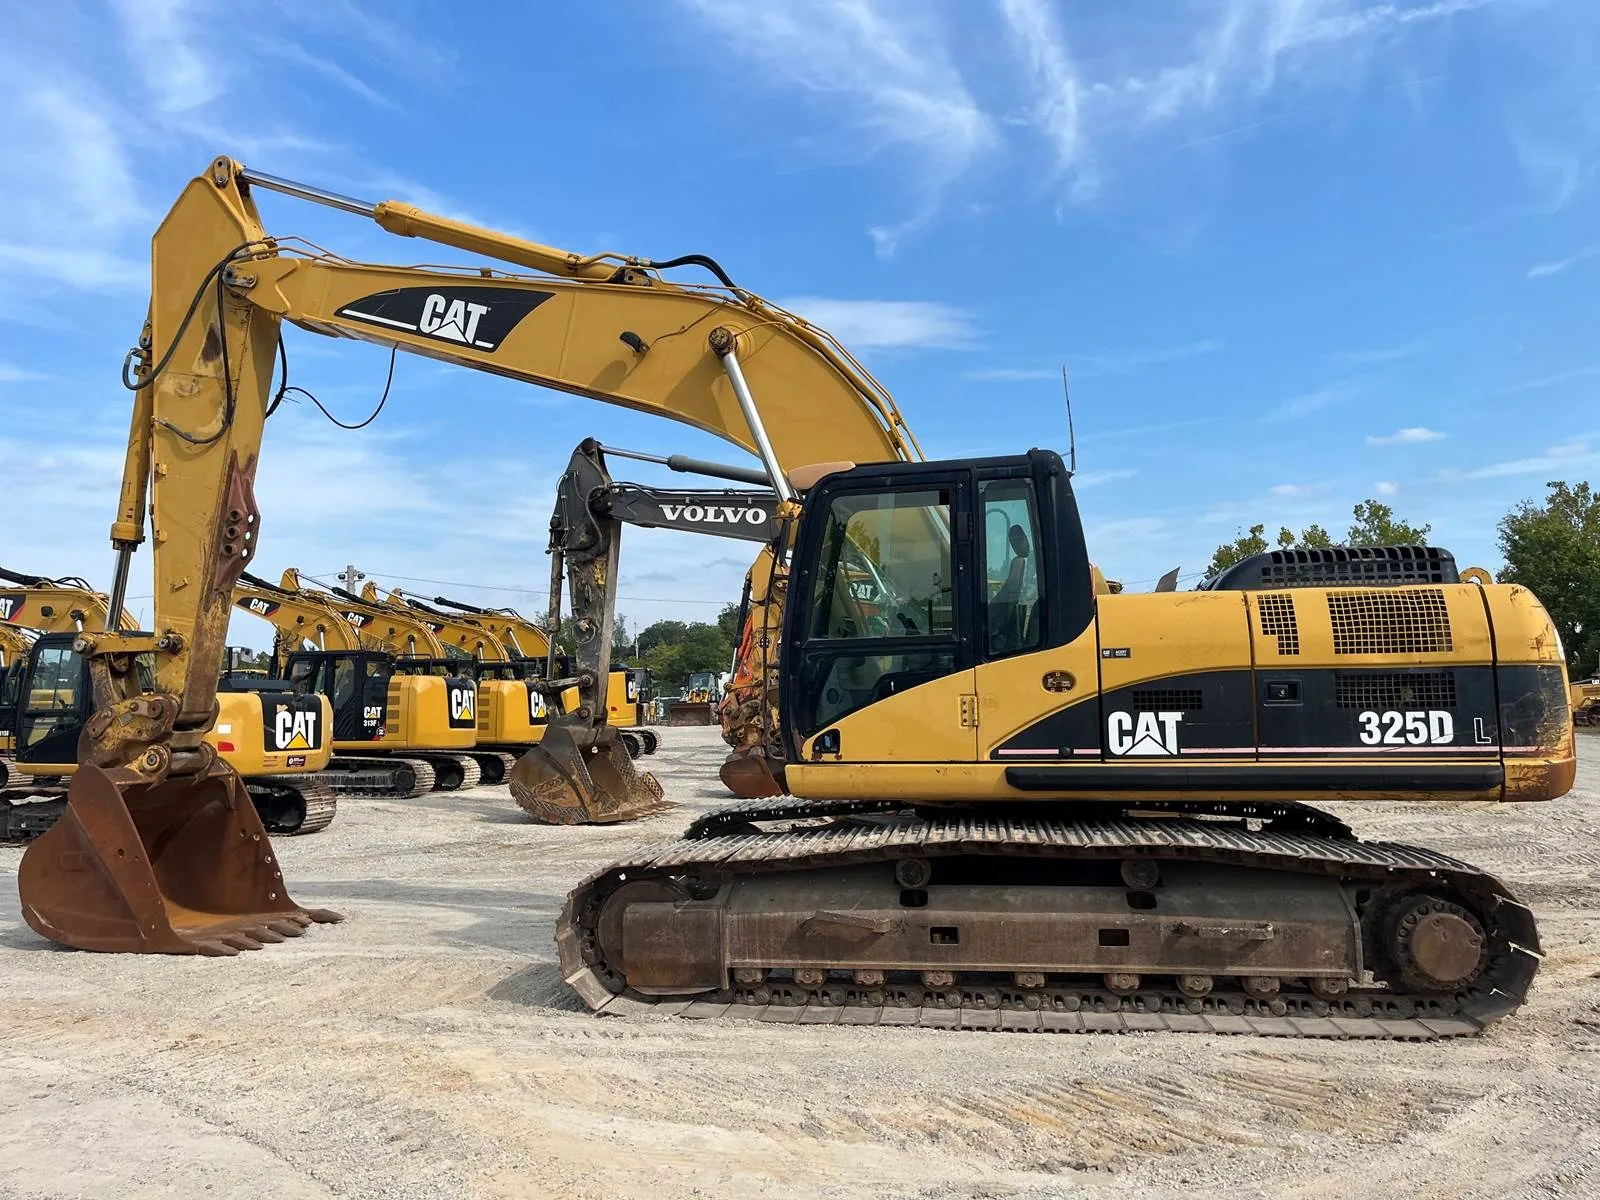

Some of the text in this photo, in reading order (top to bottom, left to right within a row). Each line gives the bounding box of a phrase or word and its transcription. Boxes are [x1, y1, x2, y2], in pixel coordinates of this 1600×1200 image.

[420, 294, 489, 344] CAT
[659, 504, 767, 525] VOLVO
[0, 597, 14, 619] AT
[250, 598, 269, 615] CAT
[347, 612, 365, 627] CAT
[364, 706, 382, 718] CAT
[451, 688, 474, 719] CAT
[530, 691, 547, 718] CA
[276, 711, 316, 749] CAT
[1108, 711, 1184, 755] CAT
[1358, 710, 1492, 745] 325D L
